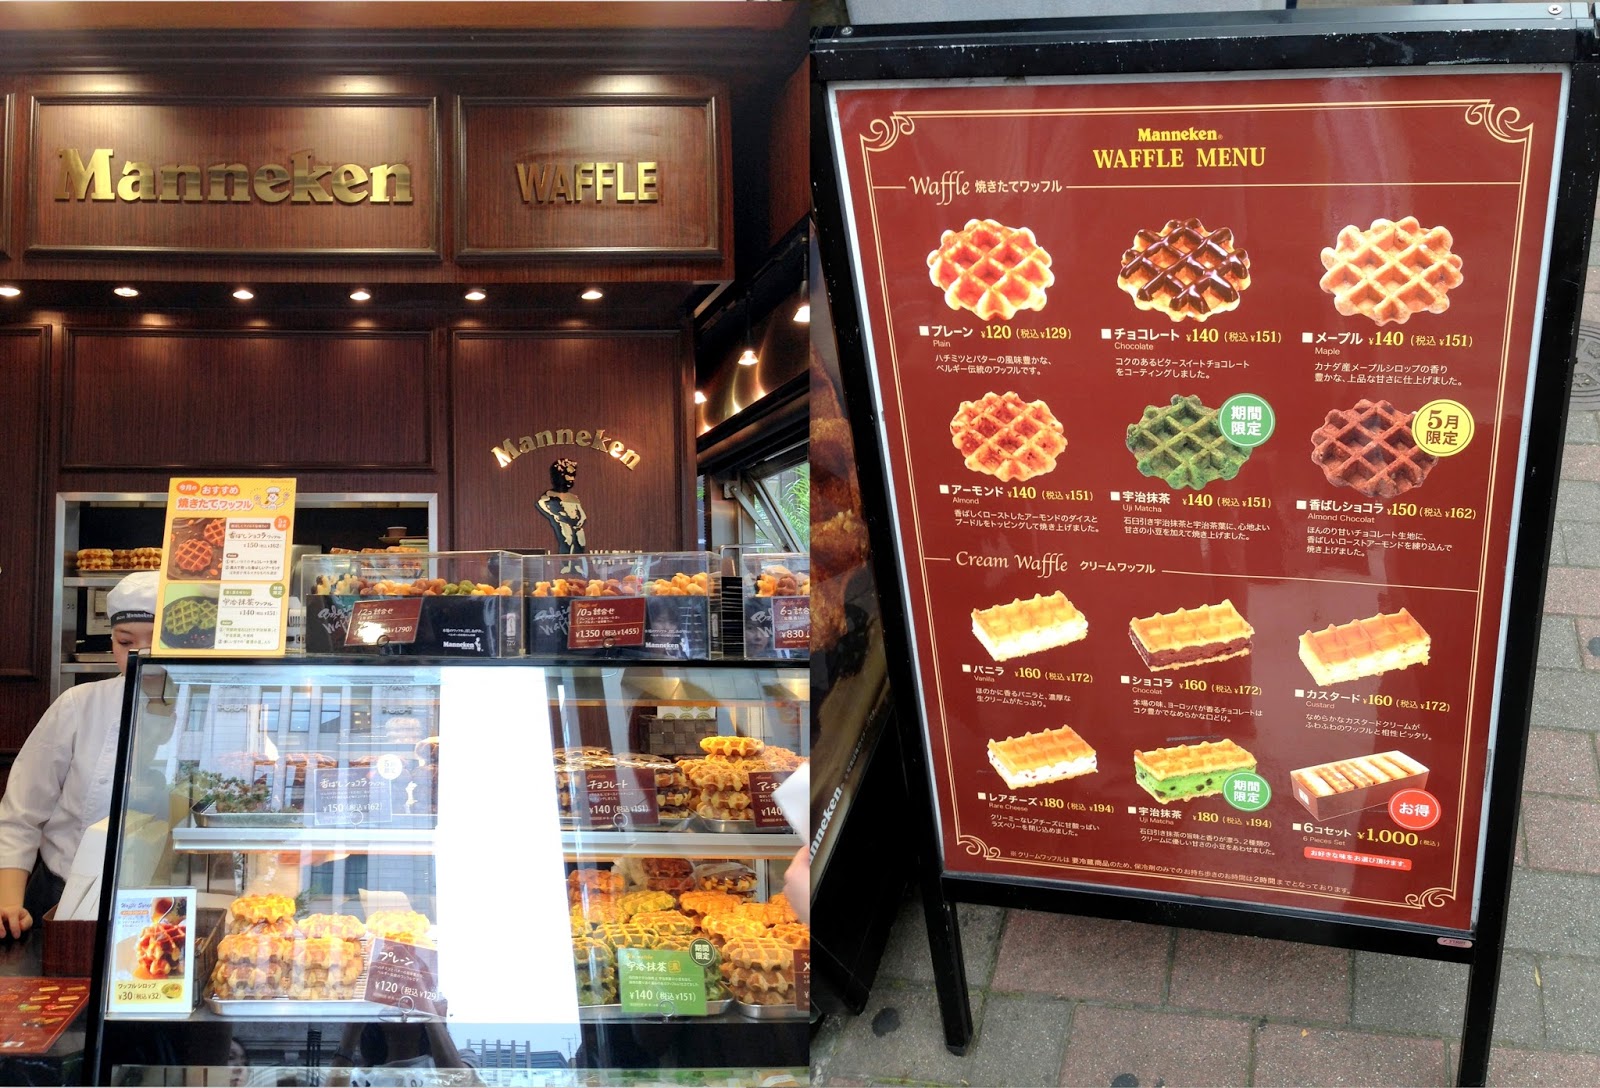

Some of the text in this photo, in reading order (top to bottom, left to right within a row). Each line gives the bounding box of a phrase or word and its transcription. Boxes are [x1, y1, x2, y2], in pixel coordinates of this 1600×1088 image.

[1137, 127, 1218, 142] Manneken
[1093, 146, 1266, 169] WAFFLE MENU
[55, 147, 412, 204] Manneken
[516, 161, 658, 202] WAFFLE
[909, 170, 970, 206] Waffle
[974, 179, 1062, 195] 焼きたてワッフル
[931, 325, 973, 338] プレーン
[980, 325, 1012, 339] ¥120
[1114, 328, 1180, 341] チョコレート
[1186, 328, 1219, 343] ¥140
[1315, 332, 1364, 345] メープル
[1368, 331, 1404, 346] ¥140
[933, 340, 951, 348] Plain
[1114, 342, 1154, 350] Chocolate
[1315, 347, 1340, 356] Maple
[1231, 405, 1262, 421] 期間
[1427, 409, 1459, 430] 5月
[1231, 421, 1262, 436] 限定
[1425, 430, 1459, 446] 限定
[491, 428, 641, 471] Manneken
[201, 484, 239, 496] おすすめ
[951, 484, 1004, 497] アーモンド
[1007, 486, 1036, 499] ¥140
[177, 498, 253, 510] 焼きたてワッフル
[952, 497, 979, 505] Almond
[1122, 491, 1171, 504] 宇治抹茶
[1182, 493, 1213, 507] ¥140
[1134, 505, 1162, 513] Matcha
[1309, 499, 1384, 514] 香ばしショコラ
[1386, 503, 1417, 517] ¥150
[1307, 513, 1375, 523] Almond Chocolat
[955, 551, 1068, 578] Cream Waffle
[1080, 561, 1156, 574] クリームワッフル
[781, 629, 804, 639] ¥830
[973, 665, 1005, 676] バニラ
[1014, 667, 1041, 679] ¥160
[1132, 676, 1173, 688] ショコラ
[1179, 679, 1207, 691] ¥160
[1132, 687, 1163, 695] Chocolat
[1306, 689, 1360, 704] カスタード
[1363, 694, 1393, 707] ¥160
[1305, 701, 1336, 709] Custard
[586, 779, 628, 790] チョコレート
[1233, 779, 1260, 793] 期間
[989, 793, 1038, 806] レアチーズ
[1039, 797, 1064, 809] ¥180
[1233, 791, 1260, 804] 限定
[589, 804, 611, 815] ¥140
[761, 806, 783, 817] ¥140
[988, 802, 1028, 812] Rare Cheese
[1399, 803, 1430, 817] お得
[1138, 807, 1182, 820] 宇治抹茶
[1192, 811, 1219, 824] ¥180
[1303, 822, 1352, 837] 6コセット
[1357, 828, 1419, 847] ¥1,000
[1309, 836, 1332, 845] Pieces
[694, 943, 711, 953] 期間
[379, 951, 414, 966] プレーン
[694, 952, 711, 962] 限定
[374, 980, 398, 993] ¥120
[629, 990, 653, 1000] ¥140
